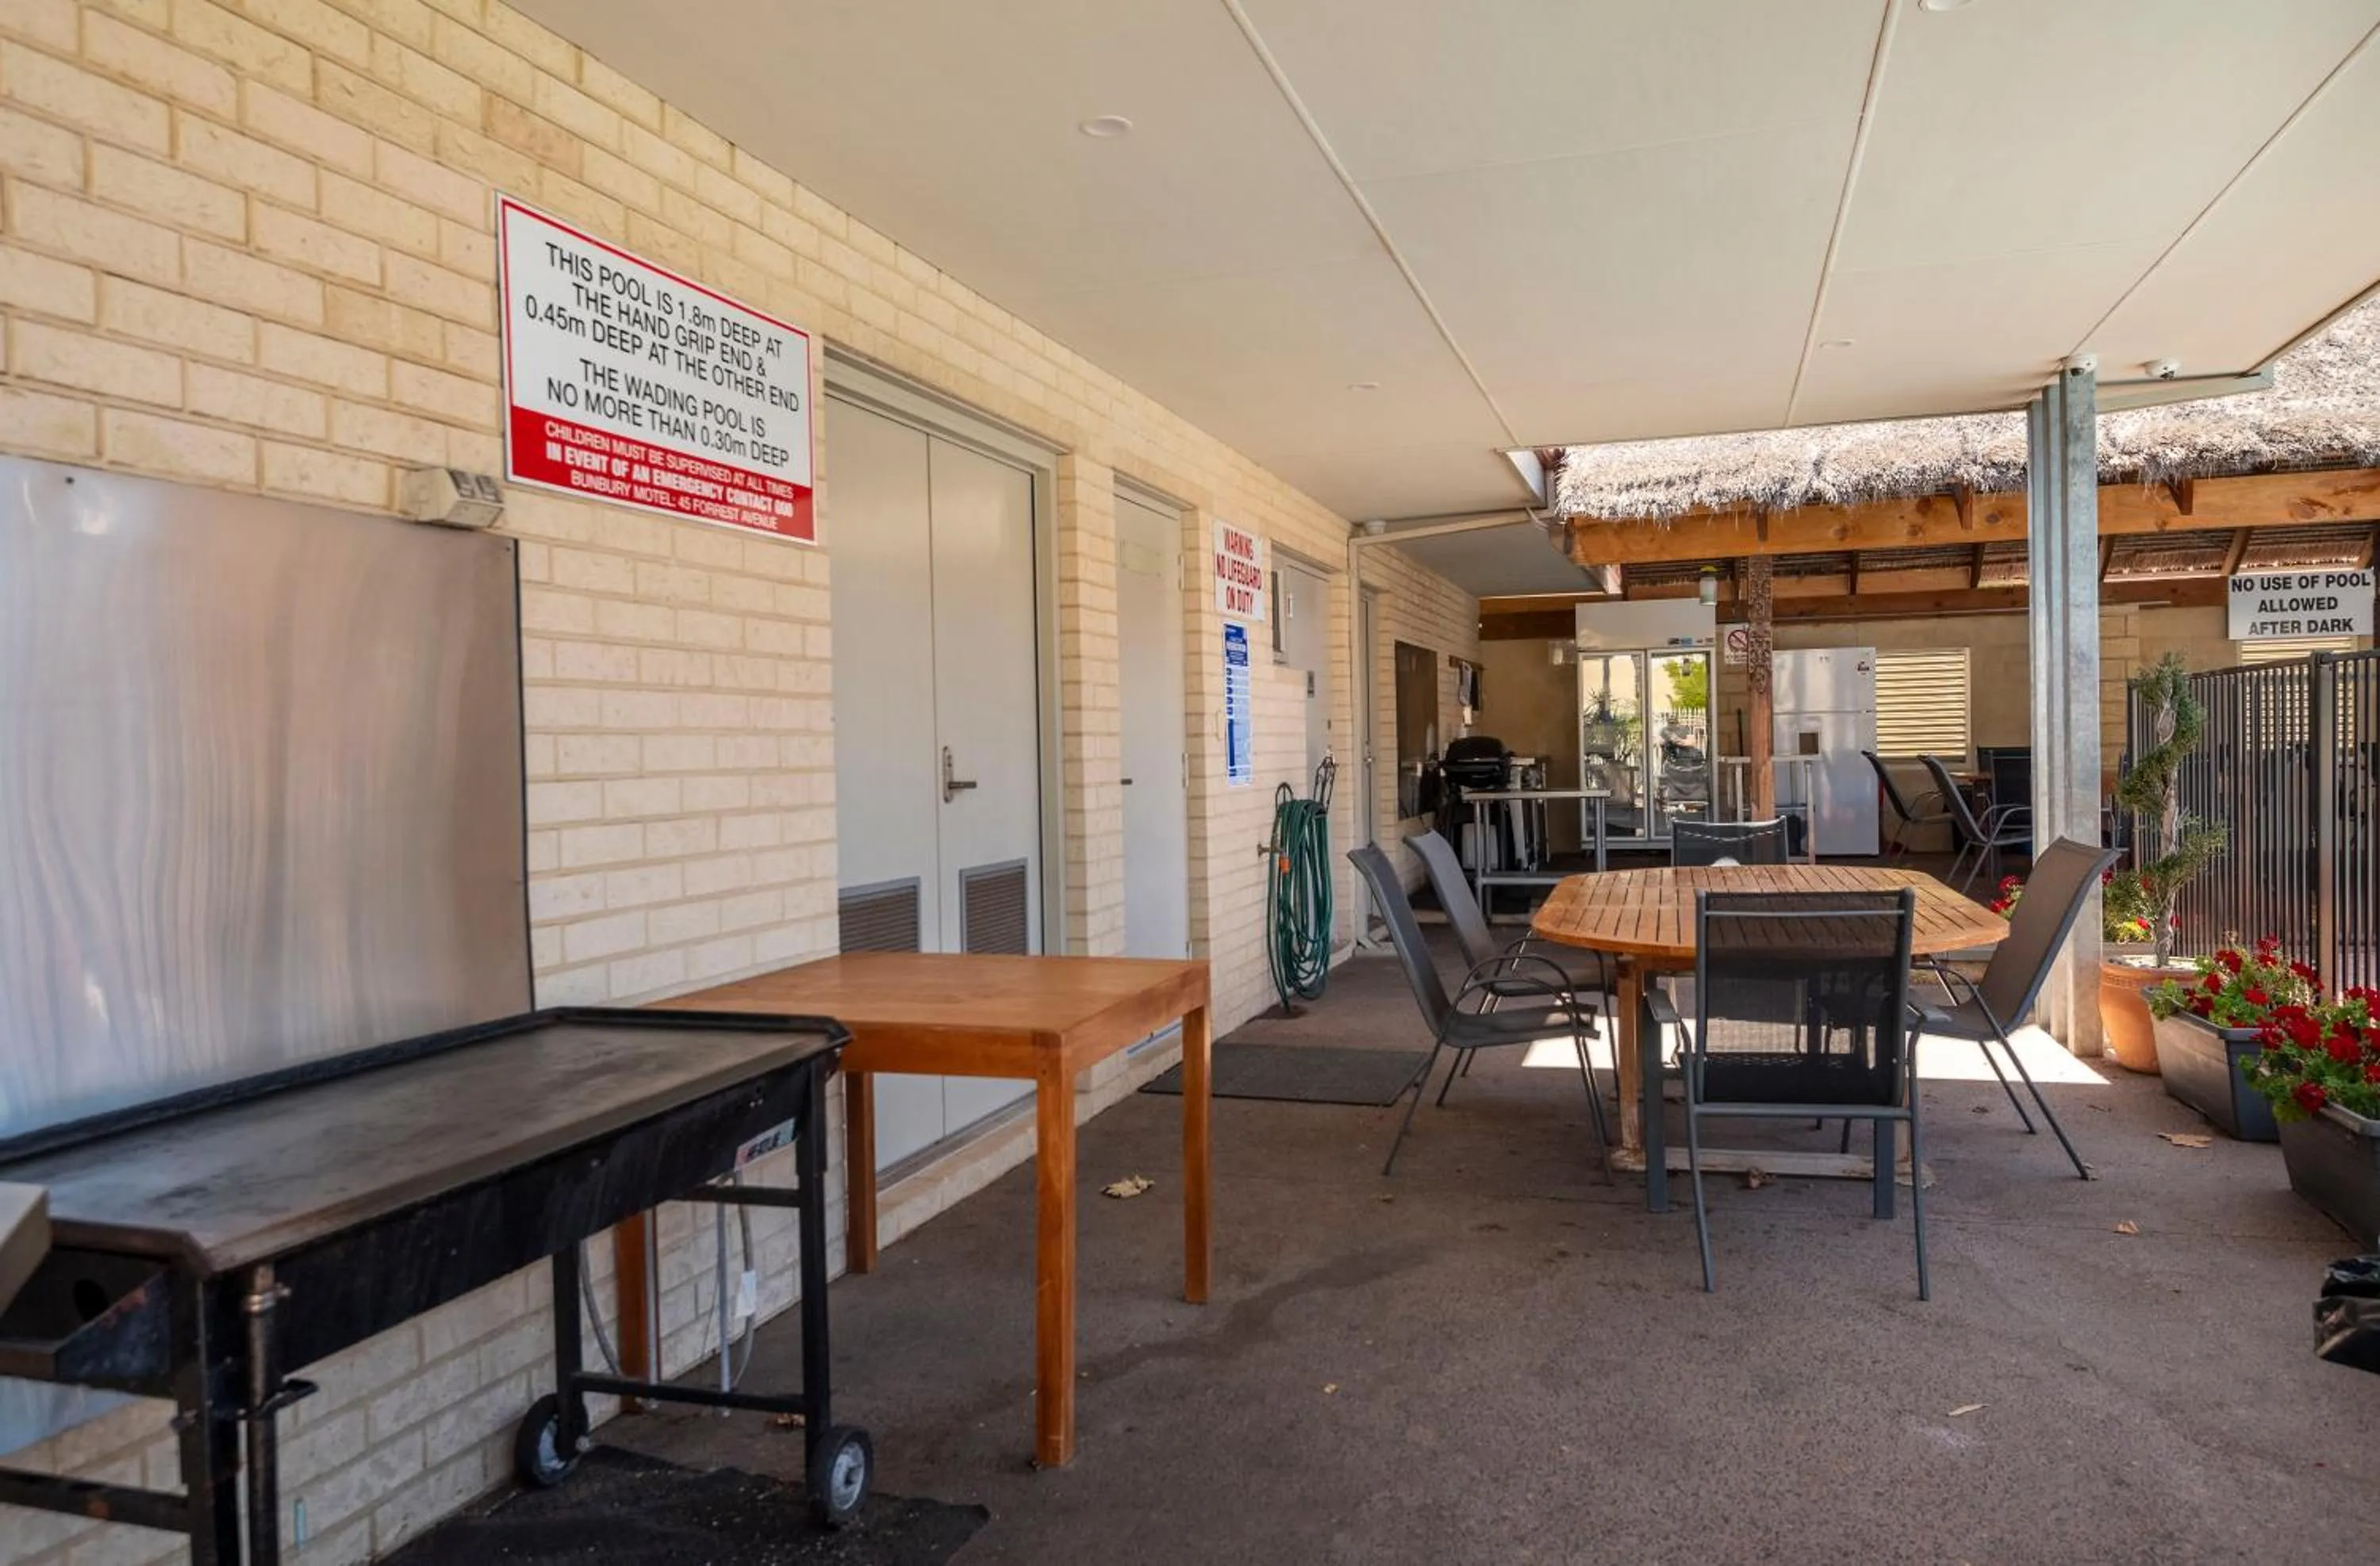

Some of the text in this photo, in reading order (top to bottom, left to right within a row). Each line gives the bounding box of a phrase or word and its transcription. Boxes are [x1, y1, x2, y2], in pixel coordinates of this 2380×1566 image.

[545, 242, 783, 359] THIS POOL IS 1.8m DEEP AT
[572, 282, 766, 378] THE HAND GRIP END &
[526, 294, 799, 412] 0.45m DEEP AT THE OTHER END
[547, 377, 789, 467] NO MORE THAN 0.30m DEEP
[580, 358, 765, 438] THE WADING POOL IS
[545, 420, 793, 498] CHILDREN MUST BE SUPERVISED AT ALL TIMES
[546, 441, 562, 462] IN
[564, 446, 608, 473] EVENT
[611, 457, 629, 477] OF
[632, 464, 649, 483] AN
[653, 468, 724, 501] EMERGENCY
[726, 487, 773, 512] CONTACT
[570, 470, 631, 497] BUNBURY
[693, 499, 740, 521] FORREST
[741, 510, 778, 530] AVENUE
[1216, 552, 1262, 590] NO LIFEGUARD
[1223, 527, 1253, 560] WARNING
[1226, 585, 1253, 616] ON DUTY
[2232, 573, 2370, 592] NO USE OF POOL
[2258, 597, 2338, 613] ALLOWED
[2248, 618, 2354, 635] AFTER DARK
